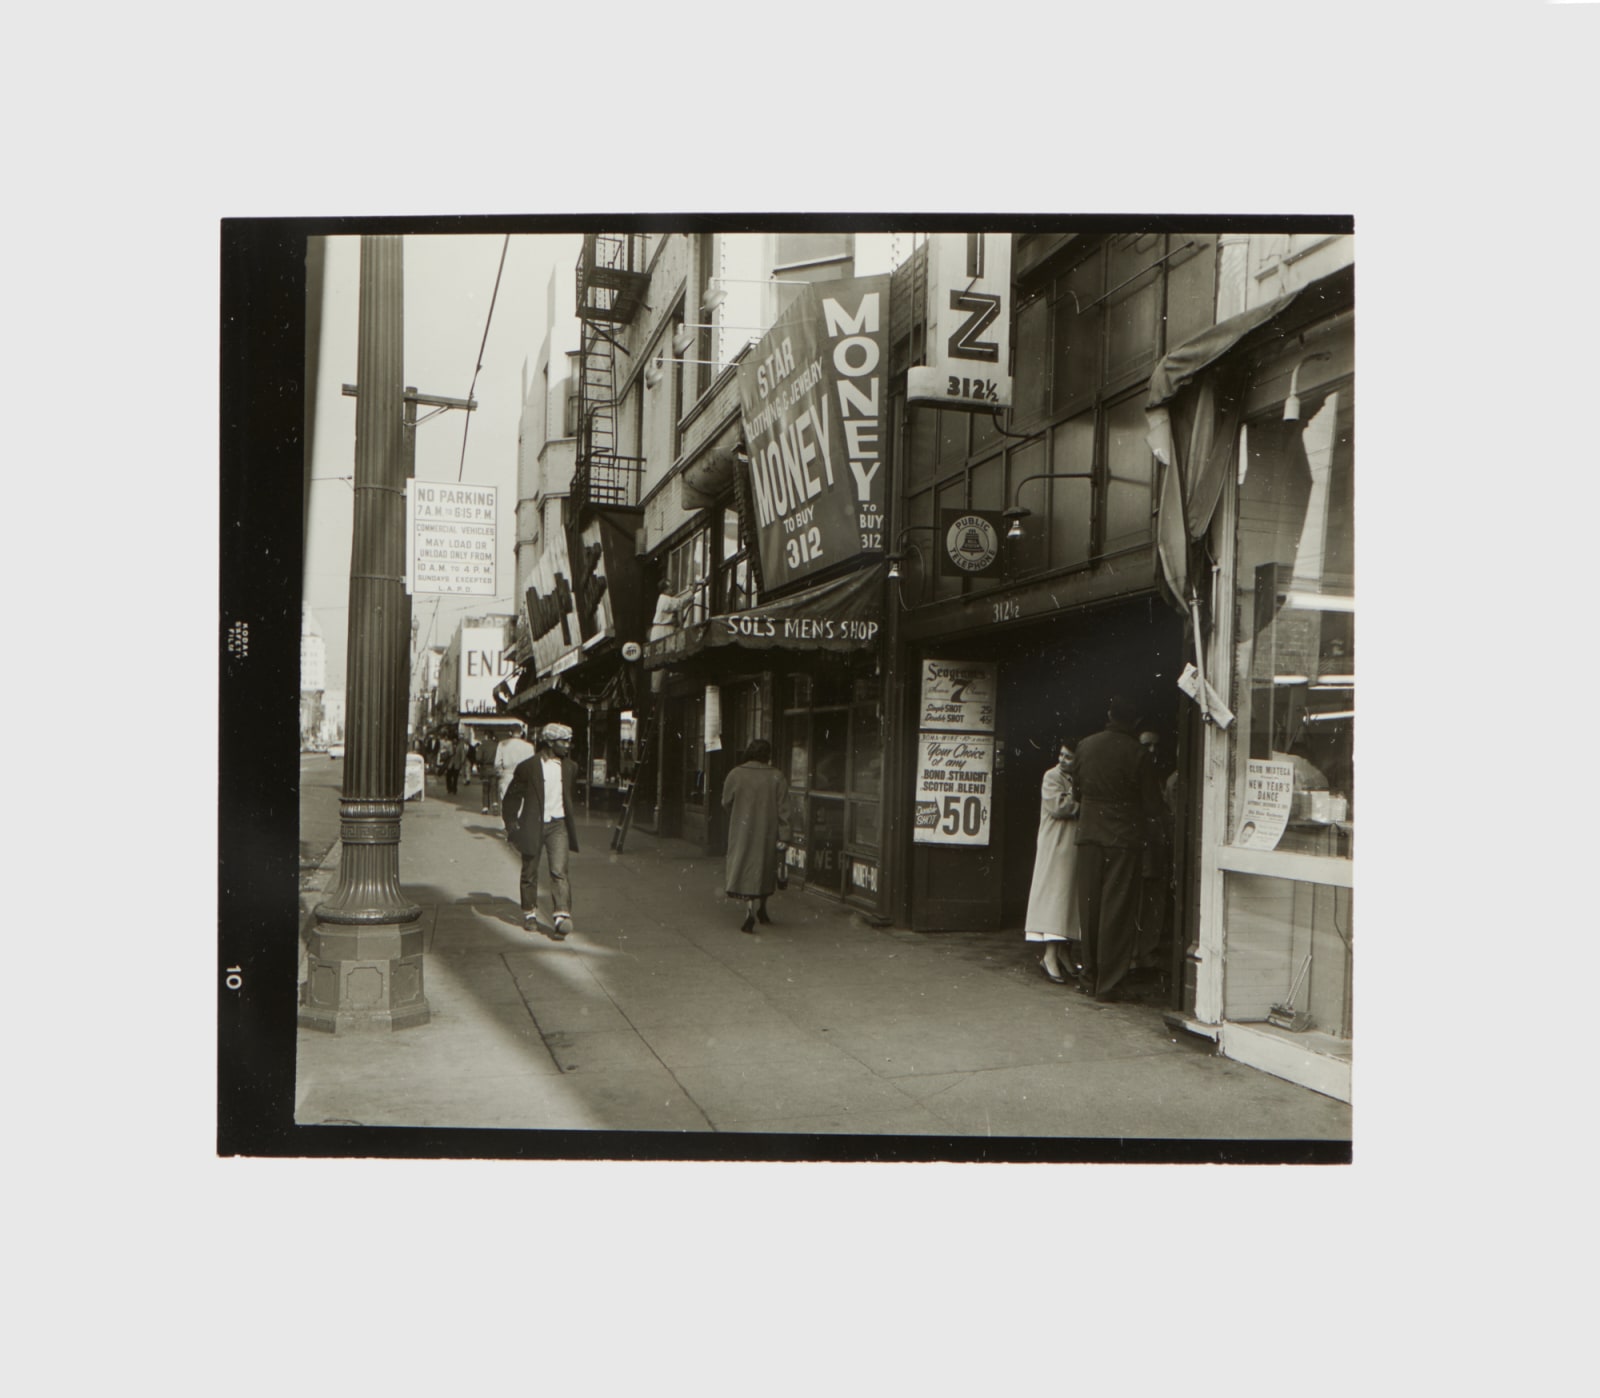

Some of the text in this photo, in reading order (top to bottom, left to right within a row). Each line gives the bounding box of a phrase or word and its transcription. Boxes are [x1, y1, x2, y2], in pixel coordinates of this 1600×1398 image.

[757, 336, 796, 400] STAR
[790, 356, 823, 405] JEWELRY
[822, 292, 881, 501] MONEY
[751, 393, 834, 528] MONEY
[418, 488, 494, 506] NO PARKING
[417, 505, 423, 515] 7
[862, 504, 877, 512] TO
[783, 505, 815, 534] TO BUY
[859, 514, 884, 529] BUY
[955, 517, 991, 532] PUBLIC
[416, 523, 494, 536] COMMERCIAL VEHICLES
[425, 538, 487, 550] MAY LOAD OR
[786, 526, 823, 569] 312
[861, 534, 882, 549] 312
[419, 549, 492, 561] UNLOAD ONLY FROM
[949, 547, 996, 570] TELEPHONE
[417, 563, 426, 571] 10
[464, 565, 470, 573] 4
[417, 574, 492, 584] SUNDAYS EXCEPTED
[727, 615, 879, 640] SOL'S MEN'S SHOP
[951, 679, 974, 704] 7
[945, 704, 962, 714] SHOT
[946, 714, 965, 723] SHOT
[927, 742, 985, 761] Your Choice
[931, 757, 966, 770] of any
[1249, 764, 1263, 775] CLUB
[923, 769, 988, 783] BOND STRAIGHT
[922, 781, 986, 794] SCOTCH BLEND
[1248, 780, 1290, 793] NEW YEAR'S
[1257, 791, 1279, 802] DANCE
[916, 814, 937, 826] SHOT
[226, 965, 242, 990] 10
